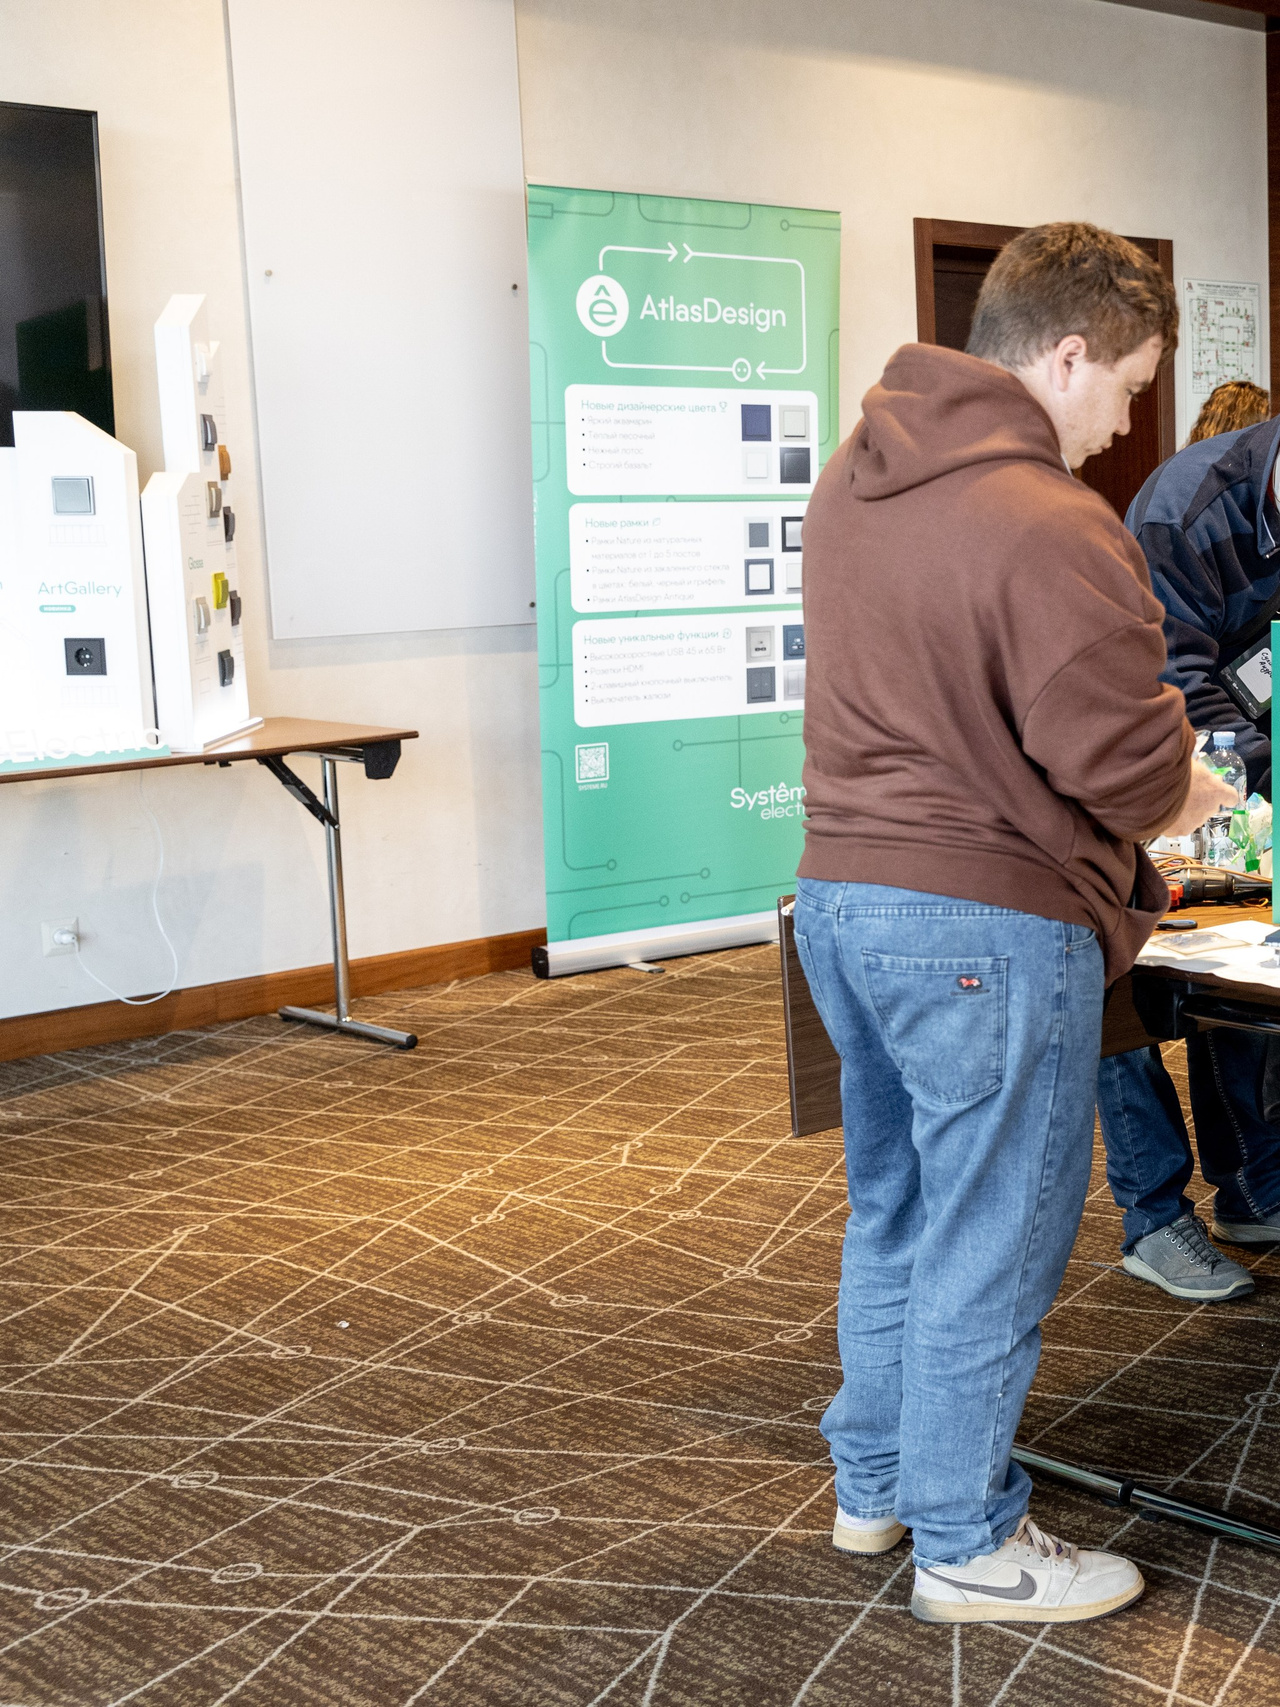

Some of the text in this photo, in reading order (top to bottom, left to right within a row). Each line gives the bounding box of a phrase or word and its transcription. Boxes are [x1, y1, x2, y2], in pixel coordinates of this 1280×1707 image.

[639, 294, 786, 333] AtlasDesign
[581, 399, 717, 413] Новые дизайнерские цвета
[587, 416, 612, 425] Яркий
[619, 432, 656, 440] песочный
[588, 446, 644, 455] Нежный лотос
[588, 461, 653, 470] Строгий базальт
[585, 518, 649, 530] Новые рамки
[591, 537, 615, 546] Рамки
[616, 536, 641, 544] Nature
[653, 536, 702, 546] натуральных
[591, 551, 637, 561] материалов
[638, 551, 647, 559] от
[653, 550, 664, 560] до
[665, 549, 671, 558] 5
[672, 550, 701, 558] постов
[592, 565, 616, 575] Рамки
[617, 565, 642, 573] Nature
[653, 563, 702, 572] закаленного
[704, 563, 730, 572] стекла
[656, 579, 685, 588] черный
[693, 576, 726, 587] грифель
[38, 581, 122, 597] ArtGallery
[593, 592, 695, 604] Рамки AtlasDesign Antique
[583, 629, 719, 645] Новые уникальные функции
[590, 645, 726, 662] Высокоскоростные USB 45 и 65 Вт
[590, 664, 644, 676] Розетки HDMI
[590, 673, 733, 691] 2-клавишный кнопочный выключатель
[591, 691, 672, 705] Выключатель жалюзи
[730, 782, 807, 811] Systêm
[761, 803, 806, 820] elect
